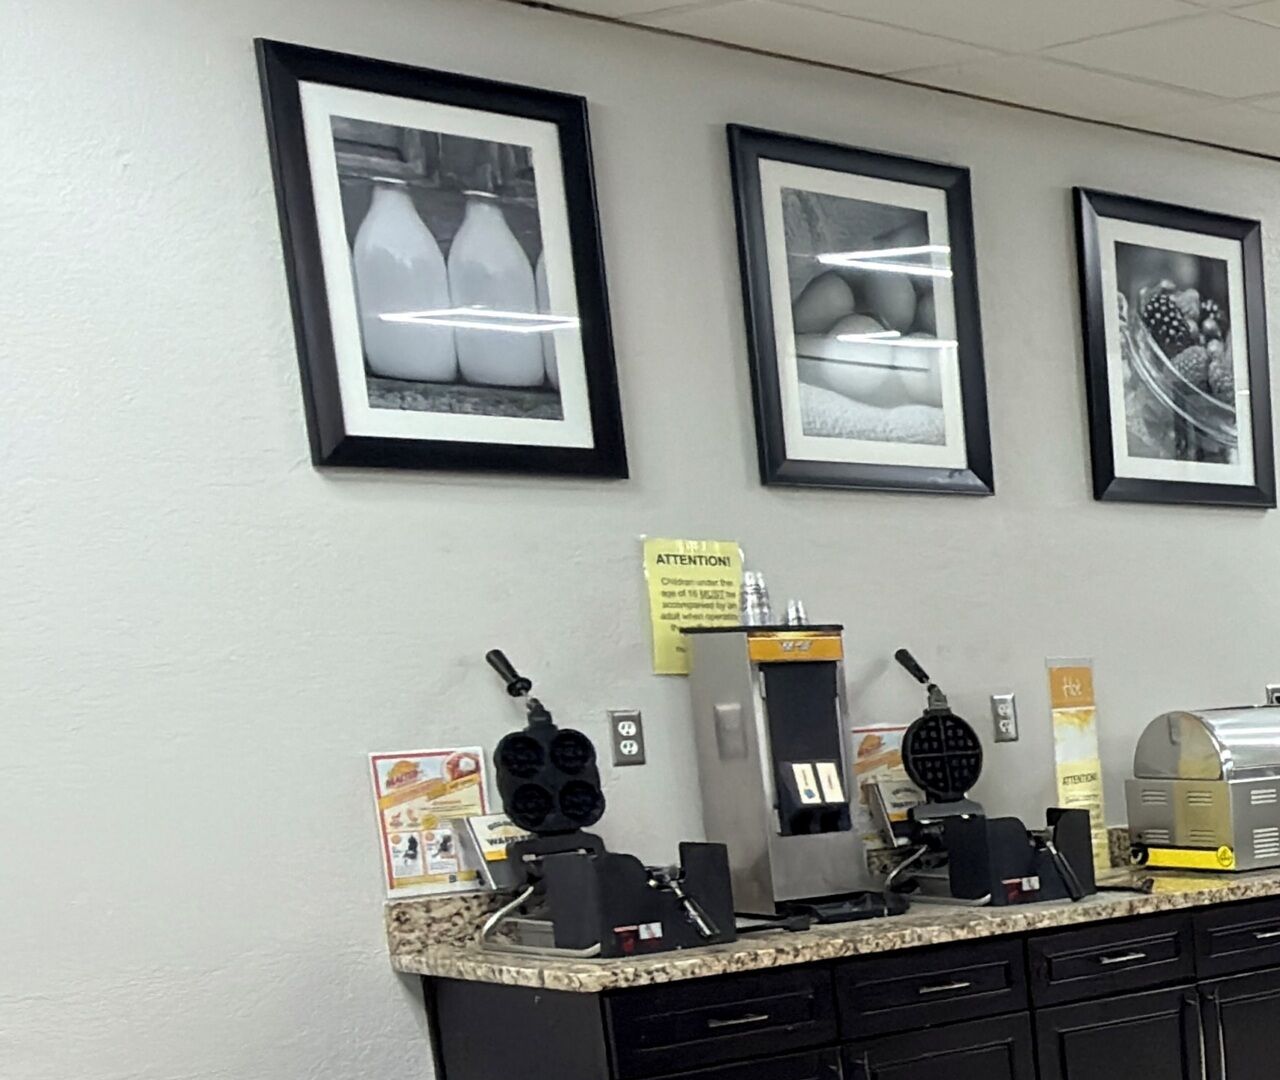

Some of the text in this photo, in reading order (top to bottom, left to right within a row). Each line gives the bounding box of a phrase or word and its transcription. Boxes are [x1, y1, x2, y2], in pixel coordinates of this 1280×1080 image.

[656, 553, 731, 568] ATTENTION!
[661, 577, 734, 587] Children under the
[661, 590, 676, 598] age
[678, 589, 686, 597] of
[662, 602, 714, 610] accompanied
[716, 602, 725, 611] by
[660, 612, 680, 620] adult
[682, 612, 703, 620] when
